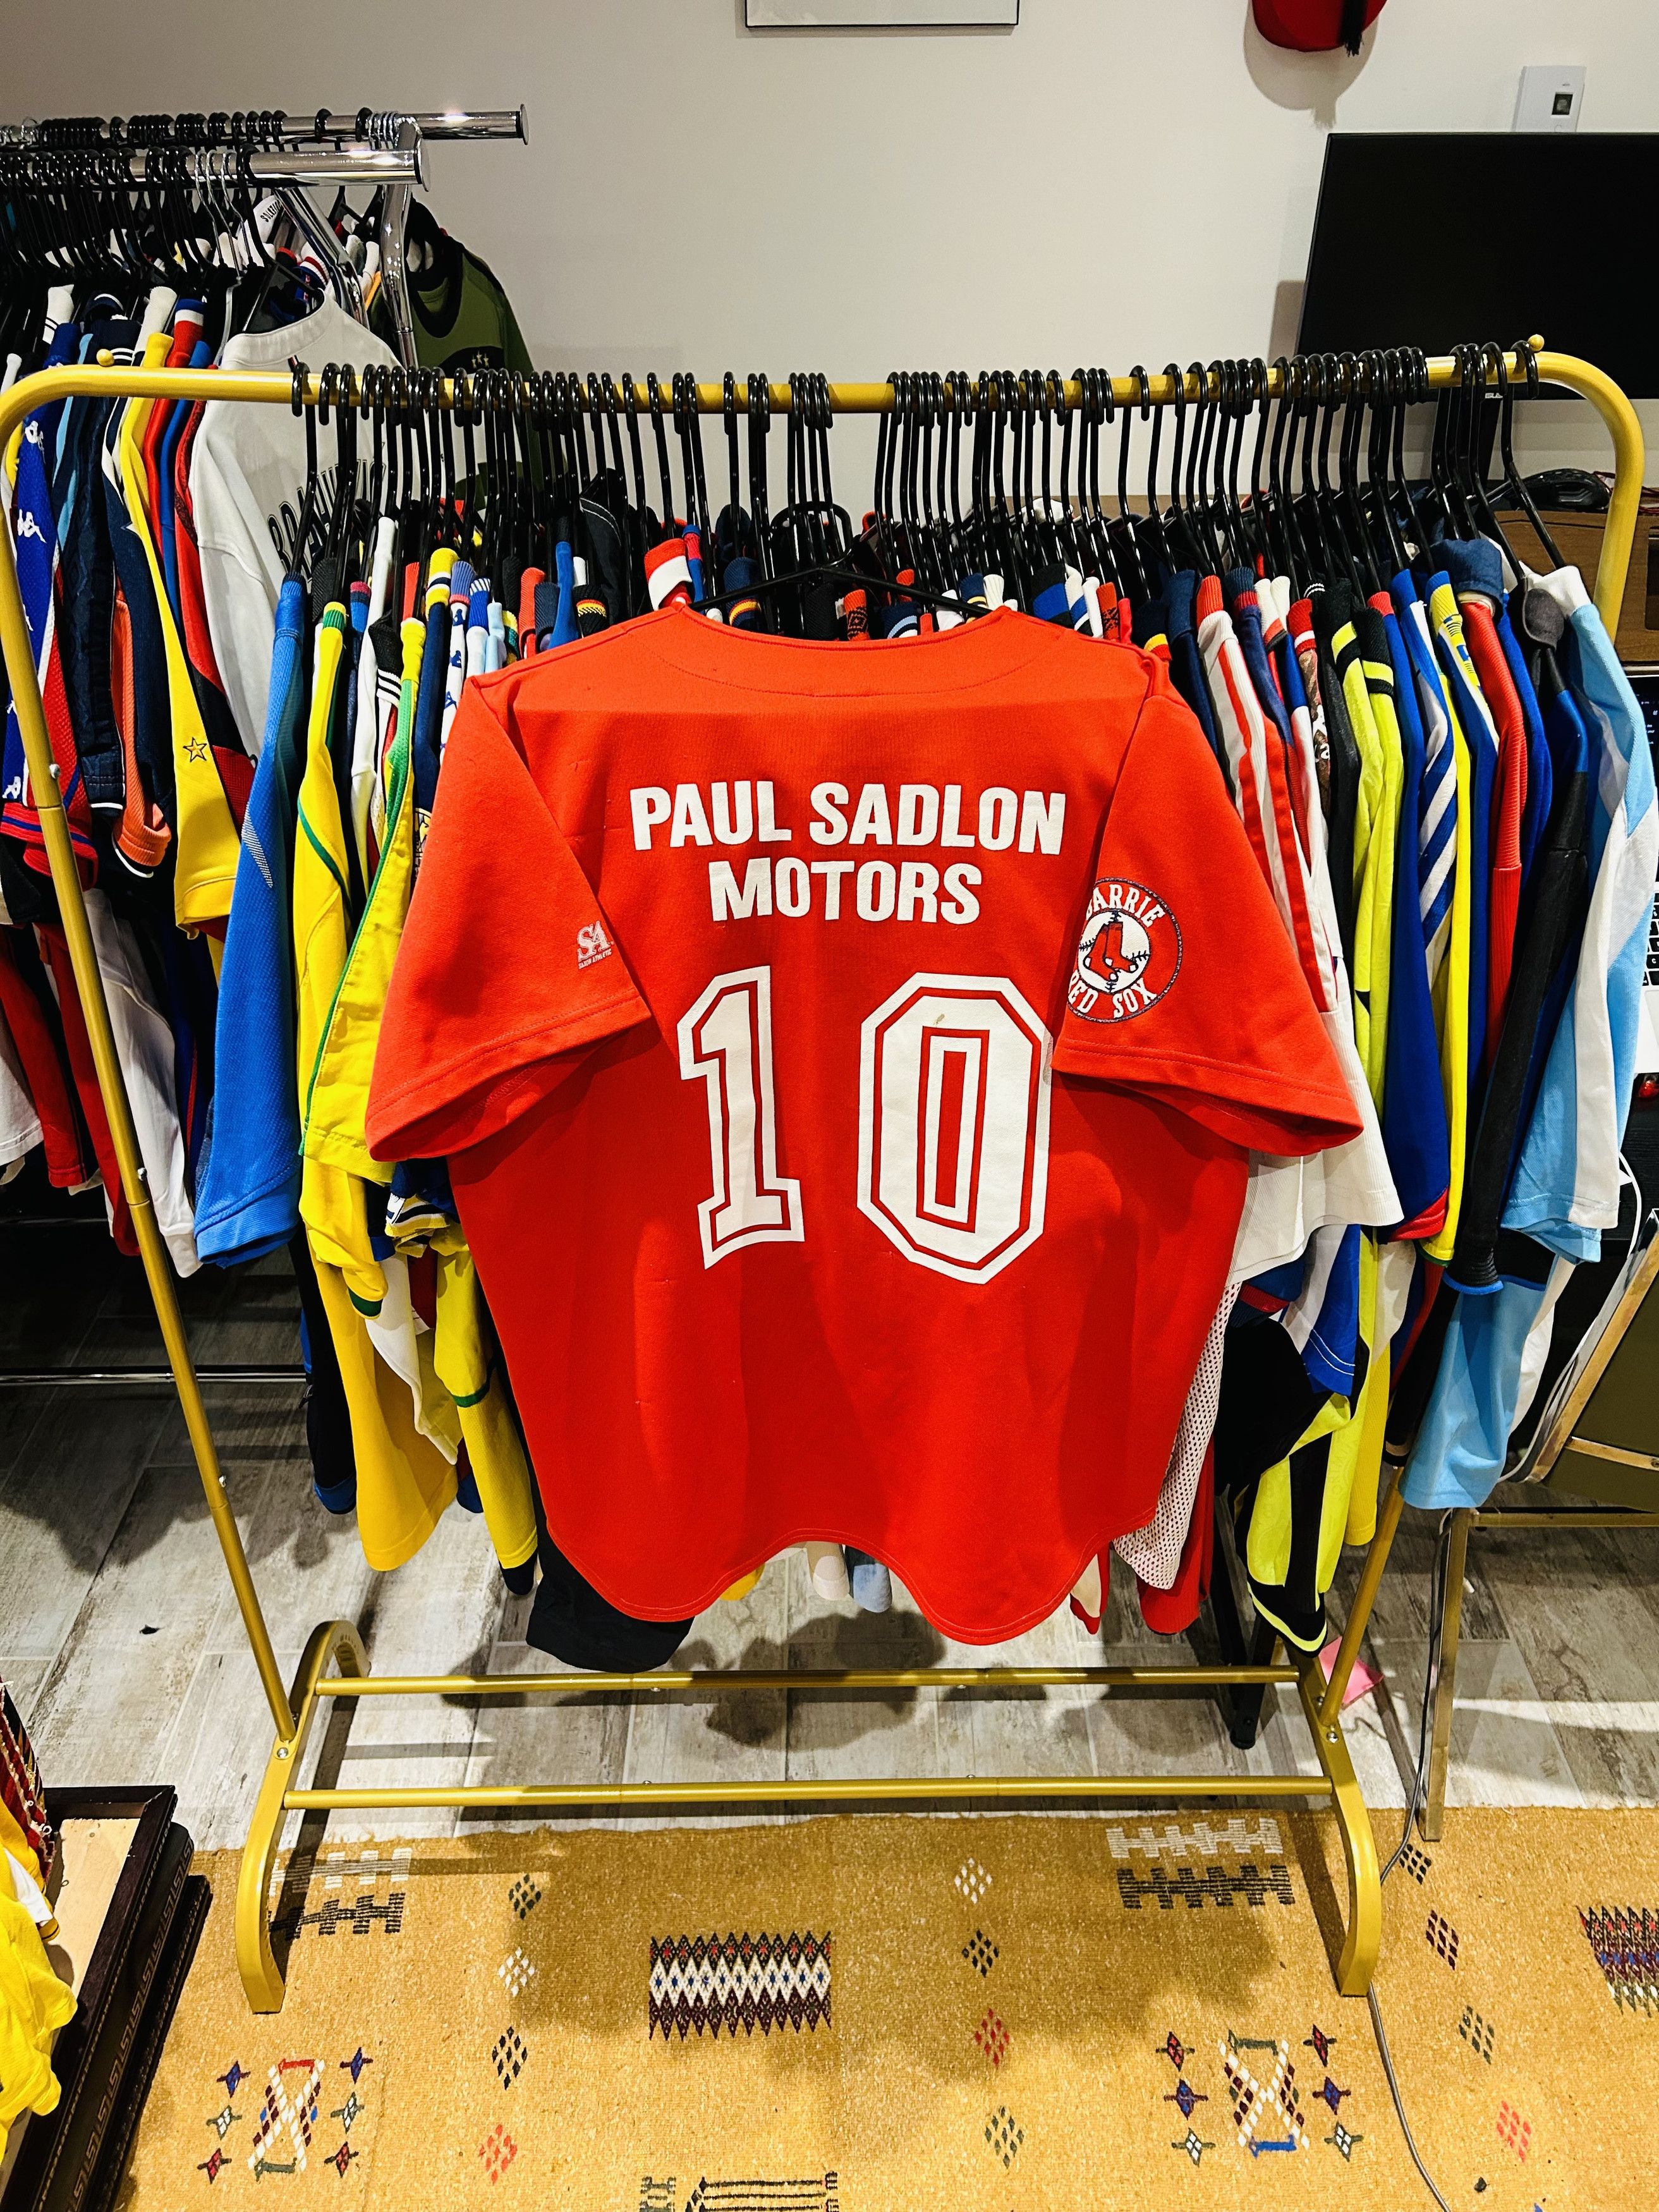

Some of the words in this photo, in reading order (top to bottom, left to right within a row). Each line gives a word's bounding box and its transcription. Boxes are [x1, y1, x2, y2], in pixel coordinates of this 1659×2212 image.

[629, 780, 792, 851] PAUL
[809, 782, 1066, 855] SADLON
[708, 857, 983, 925] MOTORS
[1068, 969, 1099, 1014] RED
[1112, 977, 1157, 1019] SOX
[677, 965, 1054, 1284] 10
